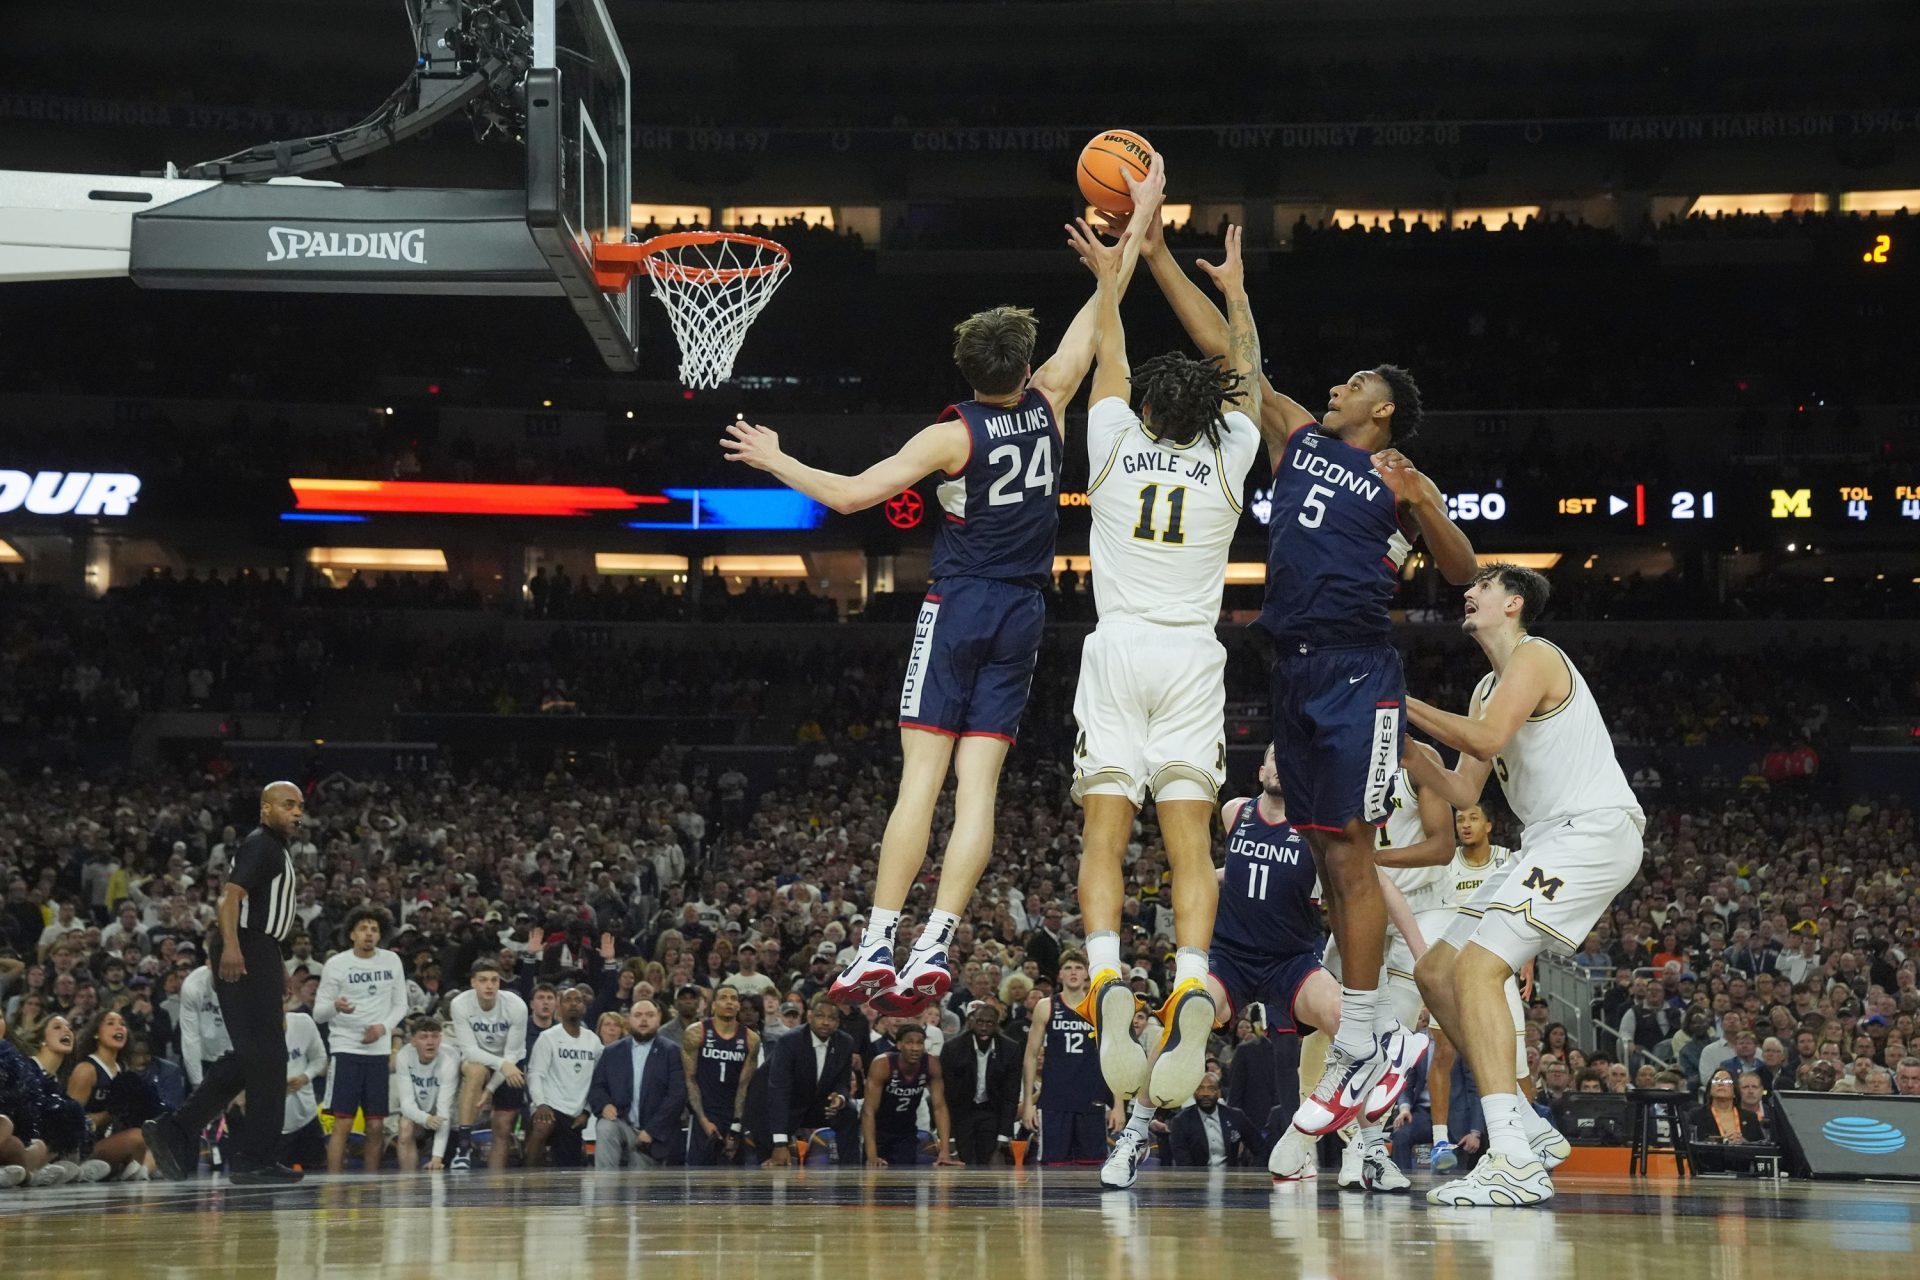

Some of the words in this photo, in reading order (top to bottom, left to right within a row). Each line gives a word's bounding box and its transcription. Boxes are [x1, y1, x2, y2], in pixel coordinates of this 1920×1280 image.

[912, 132, 982, 151] COLTS
[988, 130, 1071, 150] NATION
[1214, 128, 1272, 147] TONY
[1281, 127, 1357, 147] DUNGY
[1373, 126, 1462, 145] 2002-08
[1608, 117, 1703, 141] MARVIN
[1711, 114, 1834, 138] HARRISON
[267, 226, 425, 264] SPALDING
[984, 406, 1049, 440] MULLINS
[988, 435, 1054, 507] 24
[1122, 451, 1180, 474] GAYLE
[1180, 461, 1212, 486] JR.
[1292, 448, 1381, 502] UCONN
[1297, 483, 1335, 529] 5
[1441, 492, 1506, 521] :50
[1559, 498, 1597, 514] 1ST
[1671, 491, 1713, 519] 21
[1771, 489, 1812, 518] M
[1840, 487, 1872, 501] TOL
[1132, 481, 1186, 545] 11
[1848, 500, 1868, 521] 4
[1902, 499, 1920, 520] 4
[902, 609, 933, 710] HUSKIES
[1230, 837, 1299, 866] UCONN
[1247, 862, 1270, 901] 11
[1522, 866, 1564, 901] M
[348, 971, 372, 984] LOCK
[374, 971, 382, 982] IT
[558, 1047, 580, 1060] LOCK
[702, 1047, 746, 1062] UCONN
[1064, 1032, 1083, 1054] 12
[719, 1062, 727, 1082] 1
[895, 1097, 911, 1112] 2
